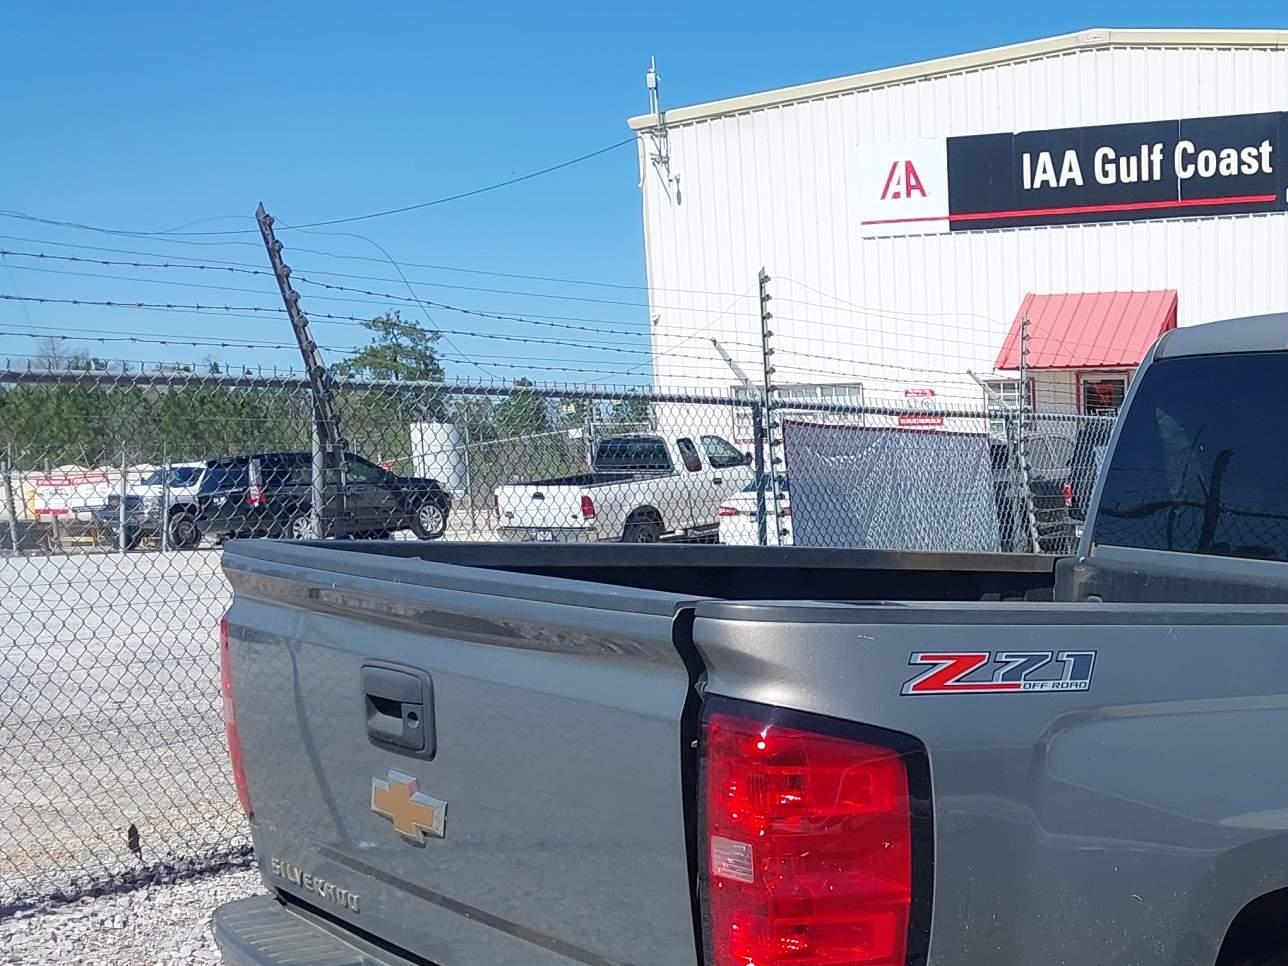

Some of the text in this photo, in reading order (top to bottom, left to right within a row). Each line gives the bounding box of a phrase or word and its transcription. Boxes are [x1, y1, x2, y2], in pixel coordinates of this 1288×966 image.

[1022, 140, 1273, 189] IAA Gulf Coast
[901, 650, 1097, 696] Z71
[1022, 680, 1088, 690] OFF ROAD
